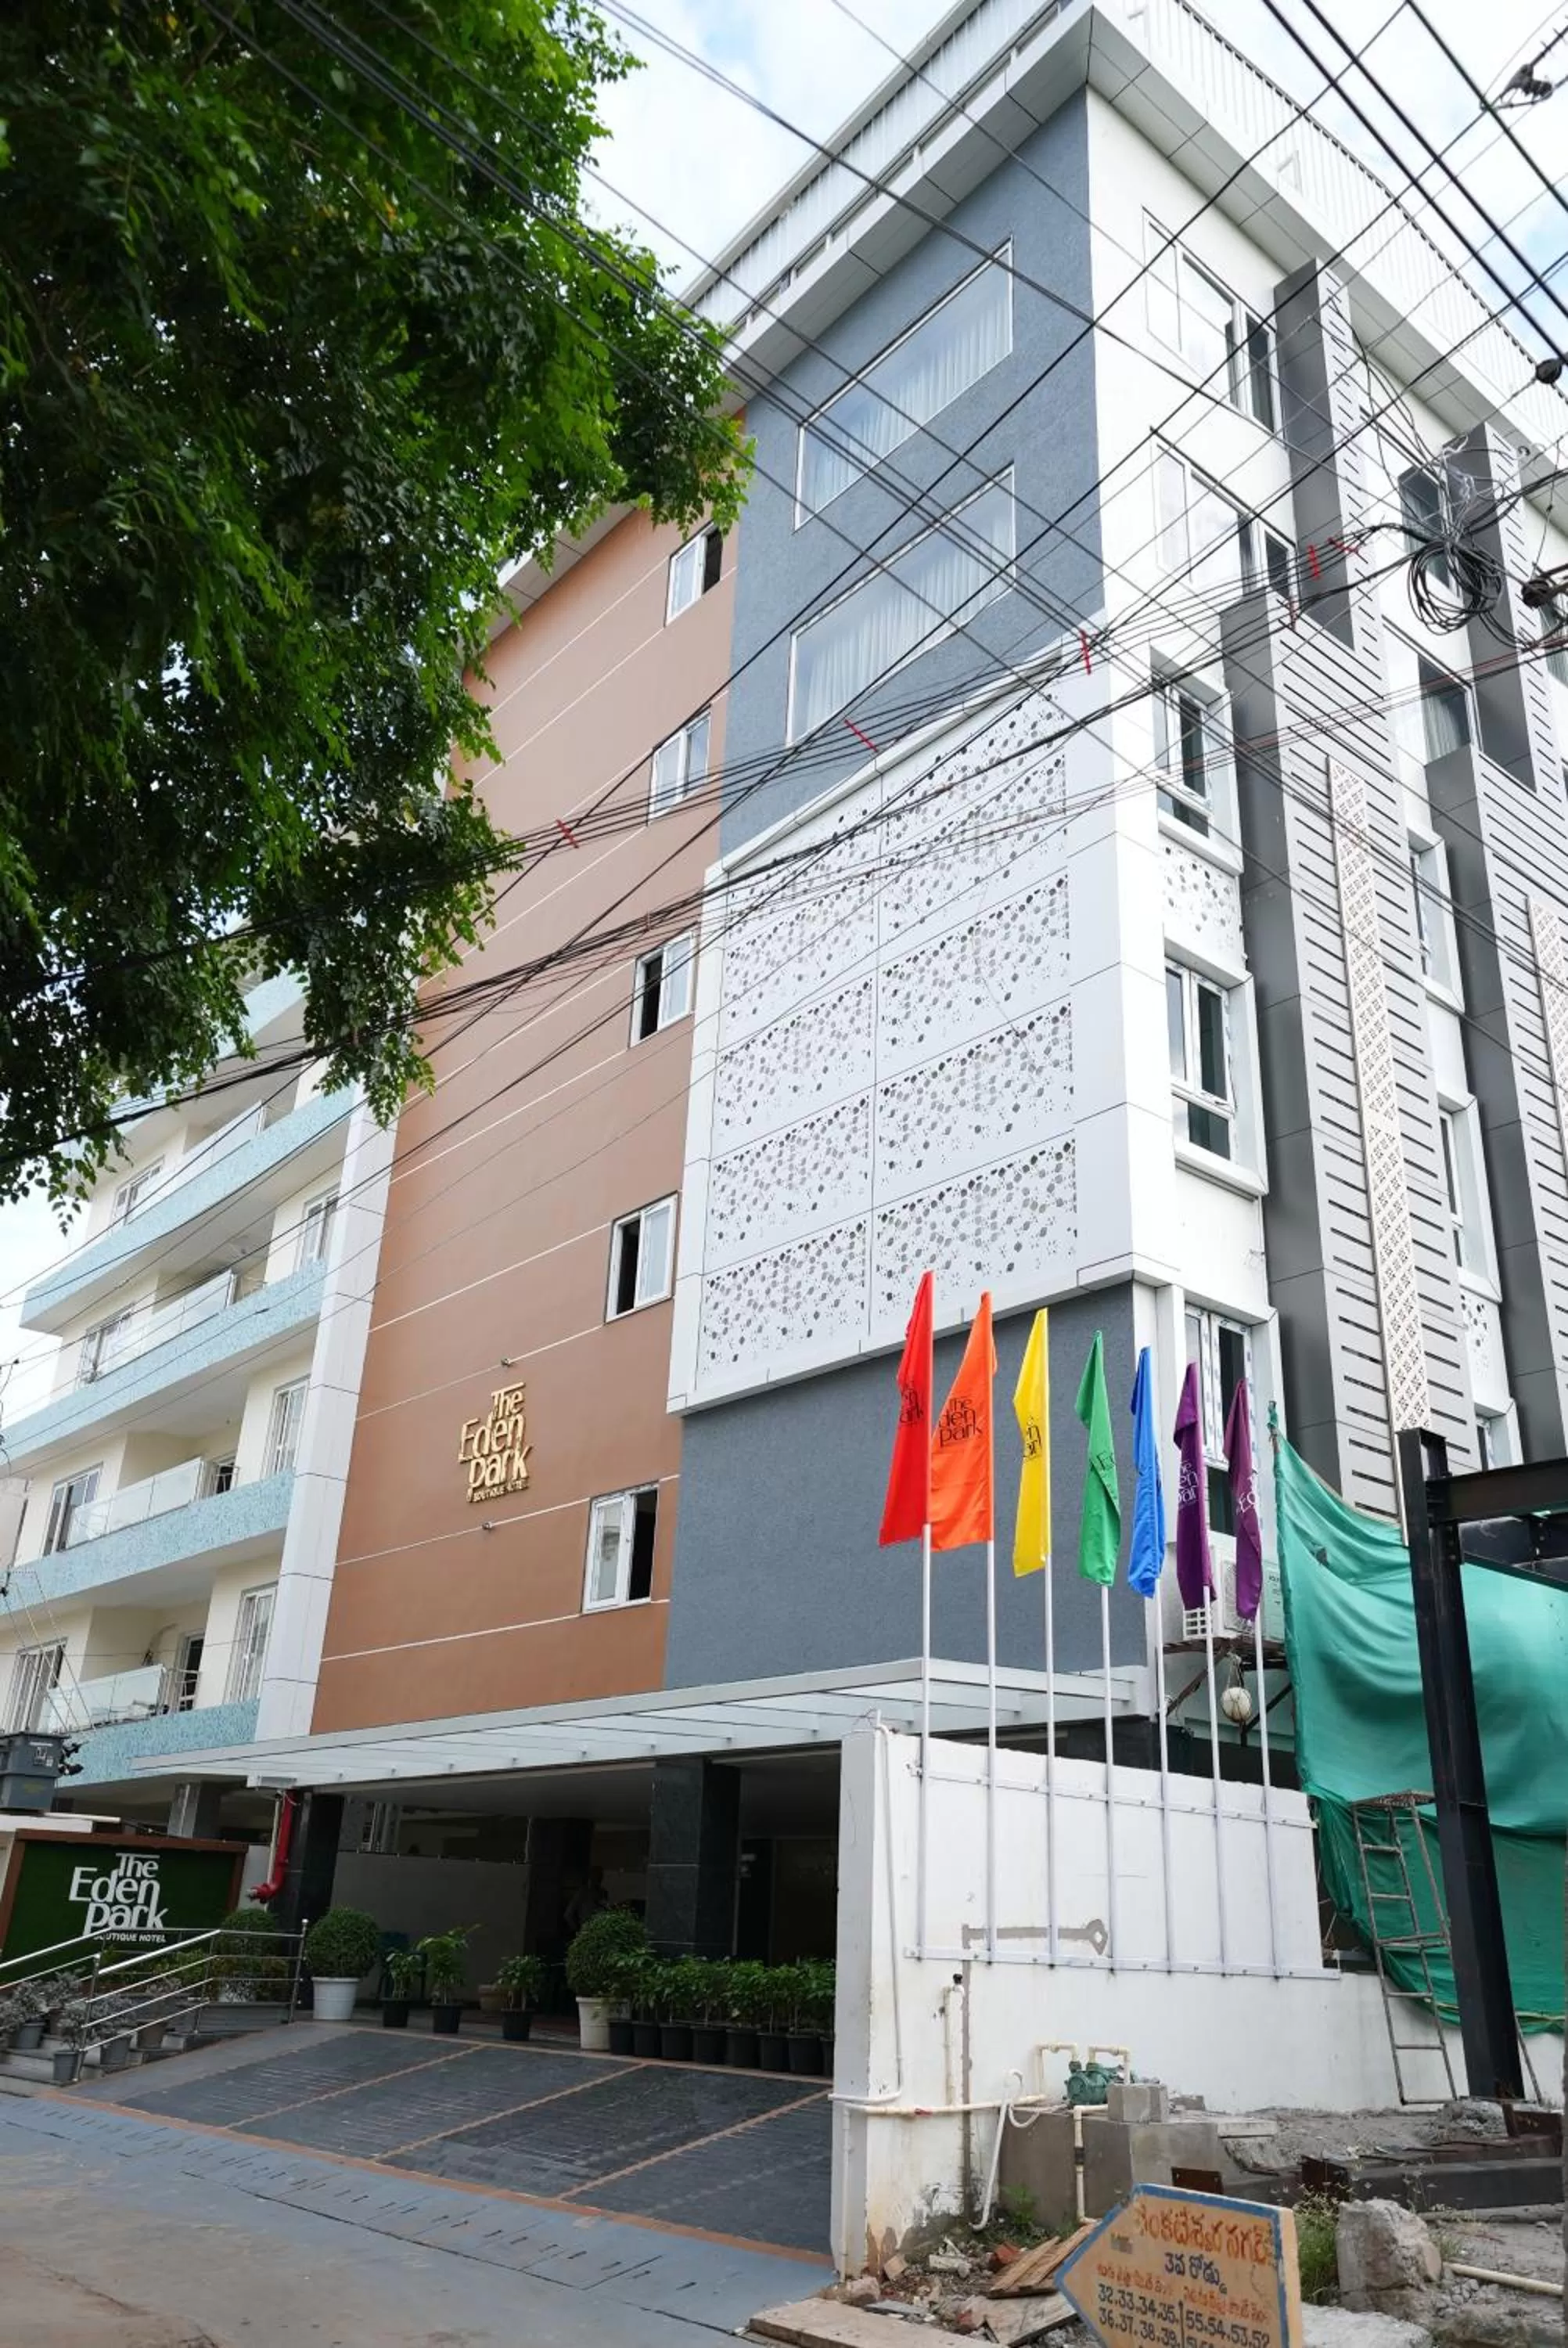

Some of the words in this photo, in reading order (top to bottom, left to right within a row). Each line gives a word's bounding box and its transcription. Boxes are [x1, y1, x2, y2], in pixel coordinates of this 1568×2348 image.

[491, 1381, 526, 1420] The
[939, 1408, 976, 1428] den
[458, 1412, 525, 1463] Eden
[115, 1853, 160, 1878] The
[69, 1867, 160, 1904] Eden
[138, 1933, 167, 1943] HOTEL
